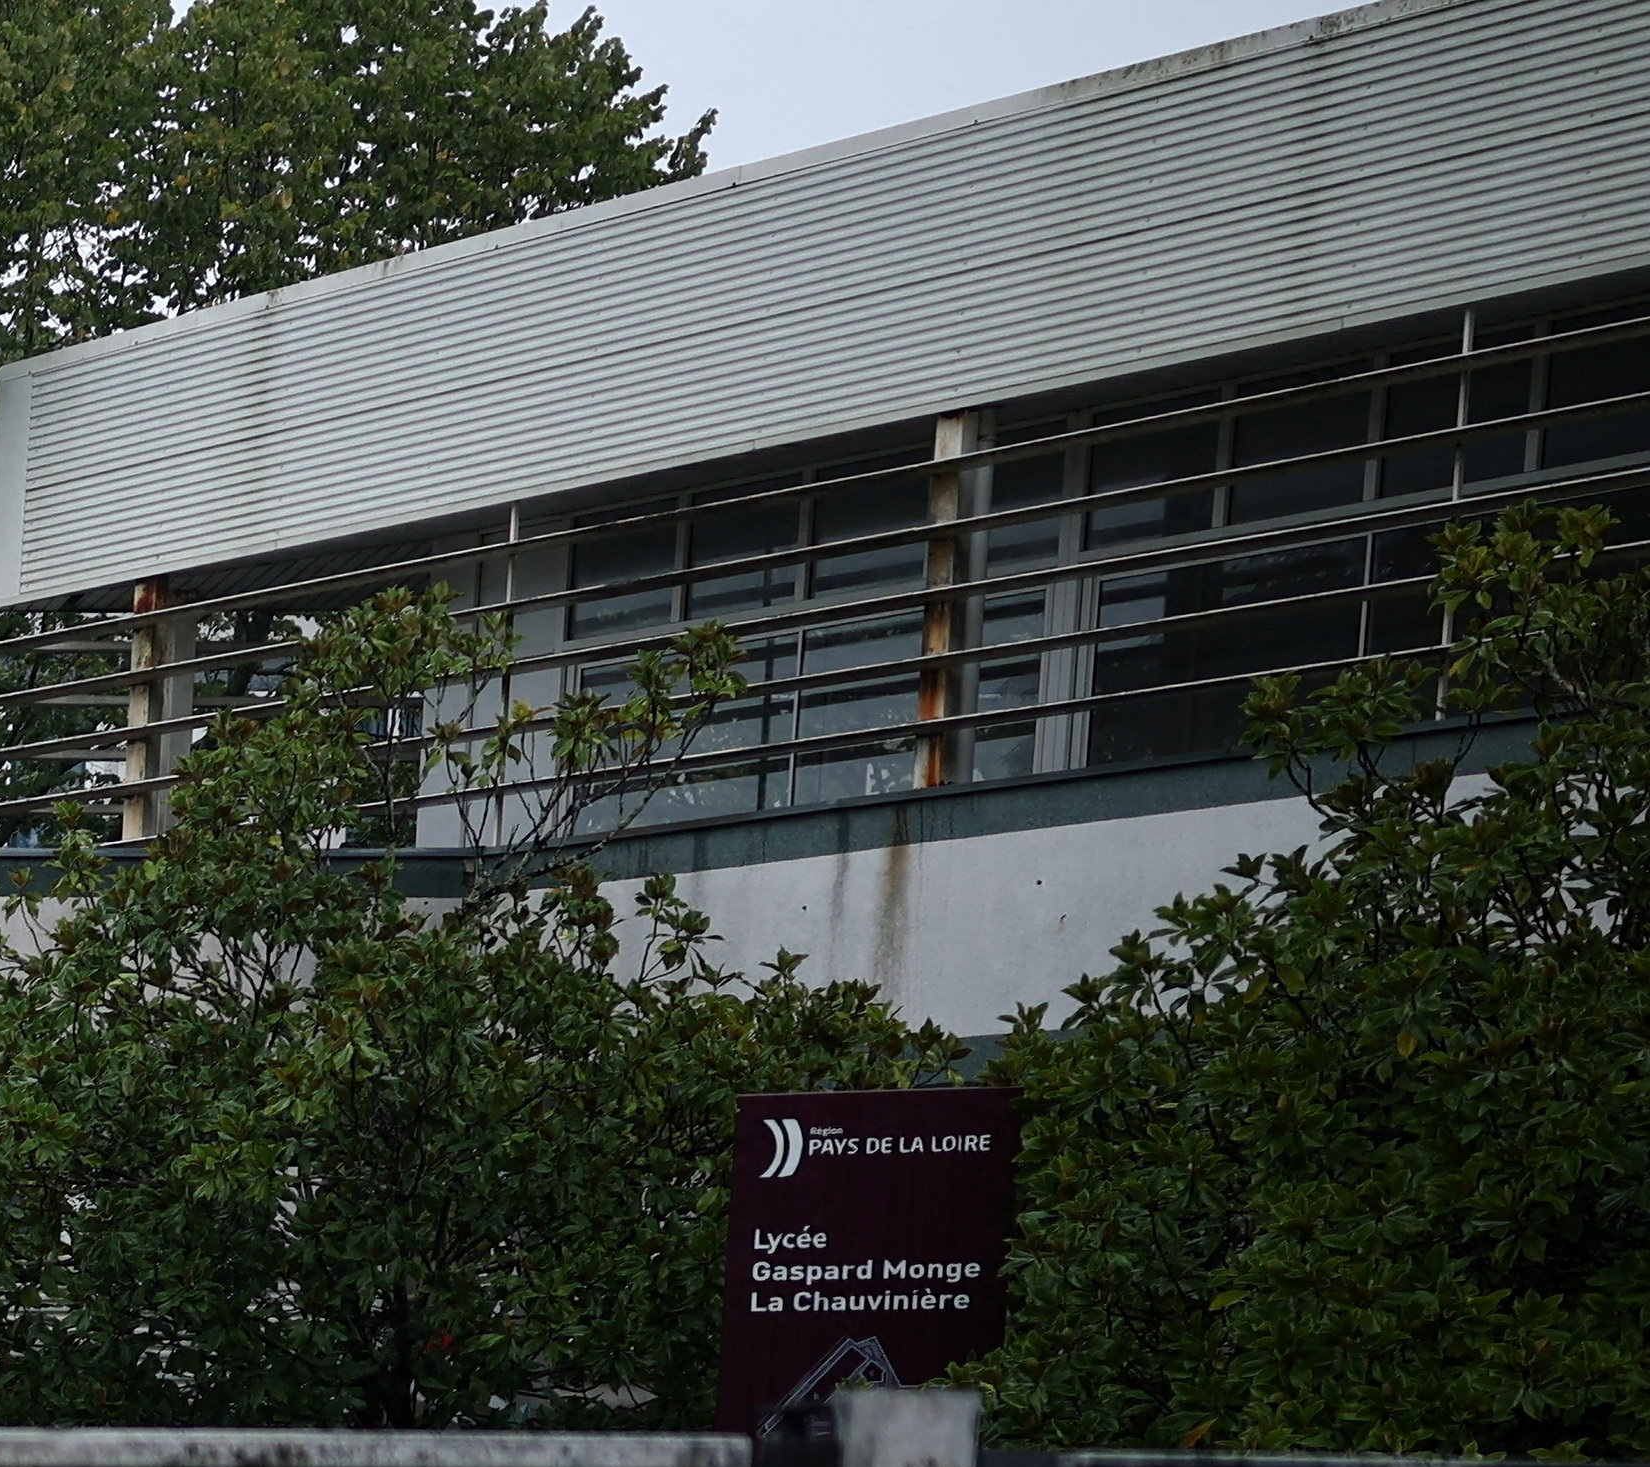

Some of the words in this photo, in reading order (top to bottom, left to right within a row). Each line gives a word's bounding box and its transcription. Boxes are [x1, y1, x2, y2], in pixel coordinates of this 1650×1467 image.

[809, 1137, 859, 1156] PAYS
[866, 1138, 892, 1155] DE
[899, 1136, 924, 1153] LA
[931, 1134, 992, 1154] LOIRE
[753, 1225, 828, 1254] Lycée
[752, 1260, 873, 1285] Gaspard
[882, 1260, 981, 1283] Monge
[751, 1292, 784, 1312] La
[793, 1288, 971, 1312] Chauvinière
